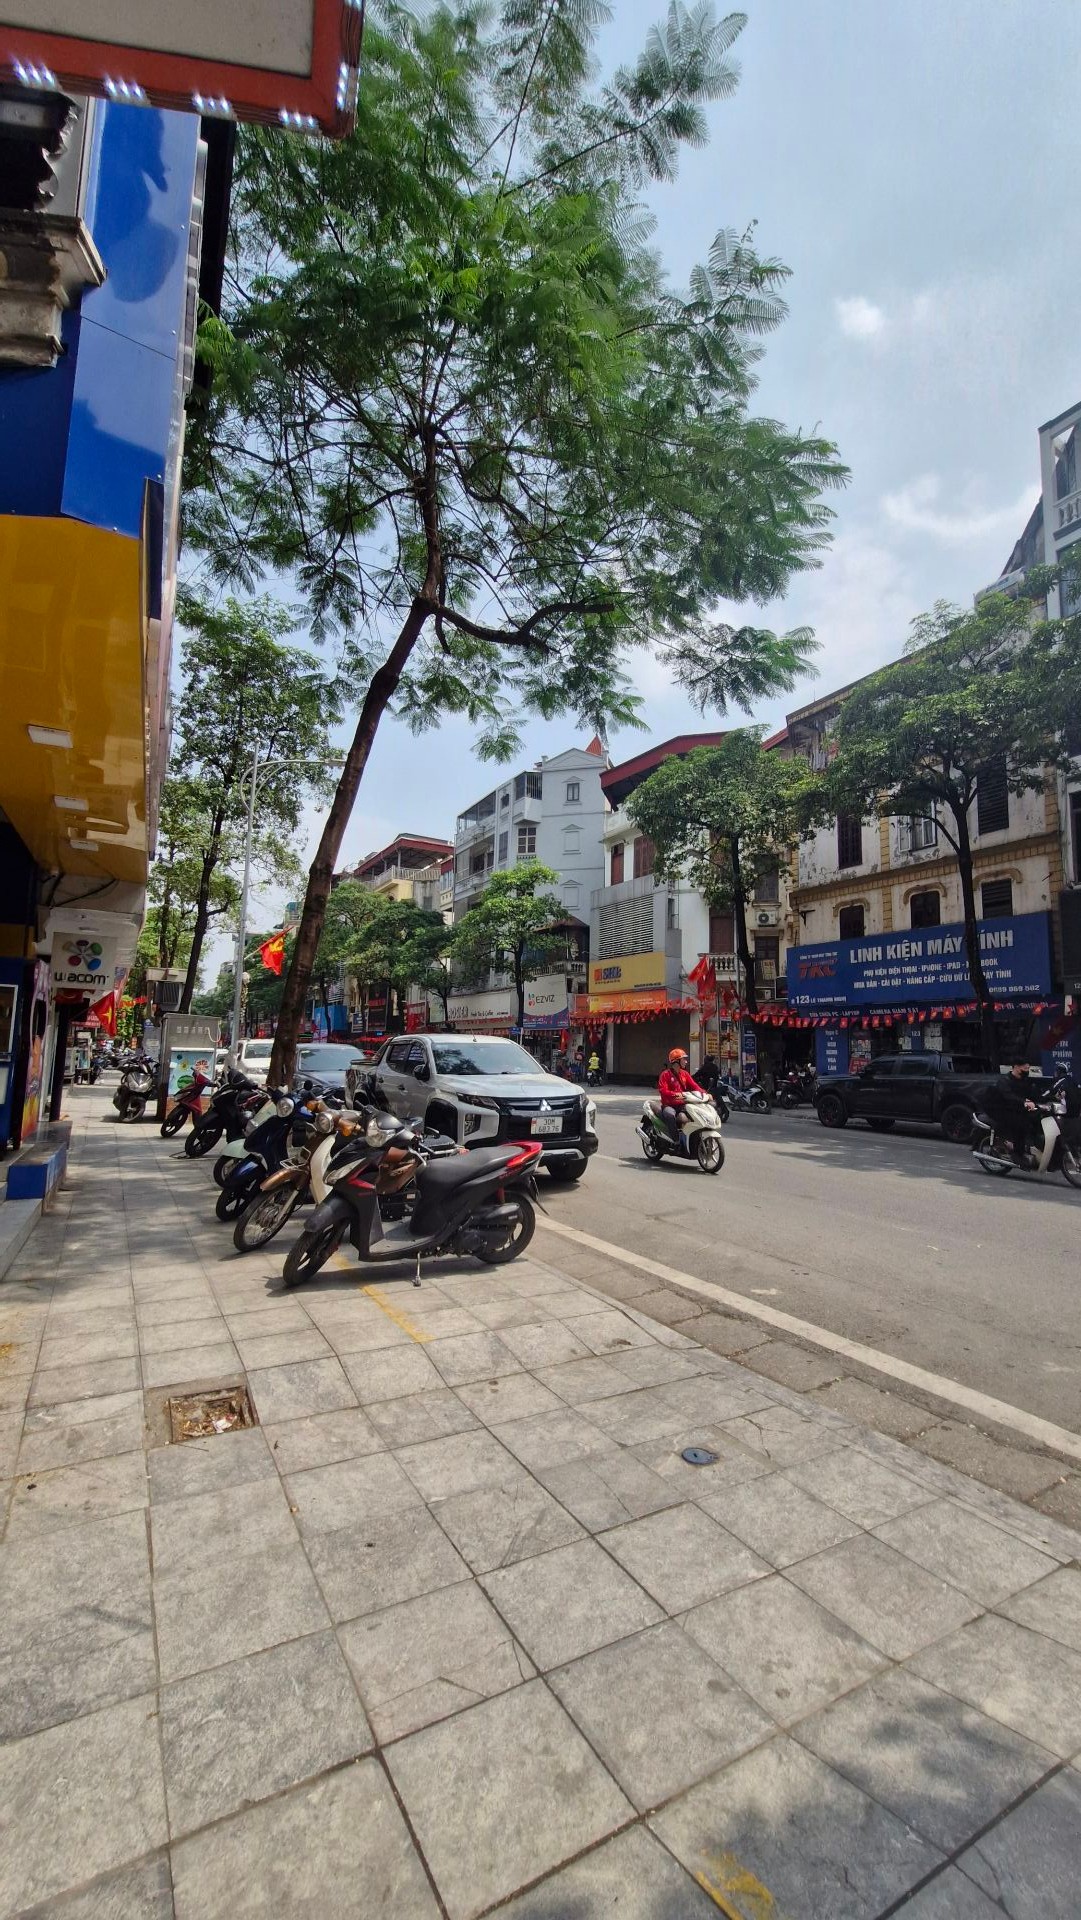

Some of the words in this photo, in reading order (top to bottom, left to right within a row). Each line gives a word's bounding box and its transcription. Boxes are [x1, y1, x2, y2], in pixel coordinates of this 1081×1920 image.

[849, 946, 882, 964] LINH
[886, 939, 923, 961] KIỆN
[927, 933, 963, 956] MÁY
[976, 929, 1014, 950] ÍNH
[54, 971, 107, 986] wacom
[535, 994, 556, 1004] EZVIZ
[795, 995, 810, 1004] 123
